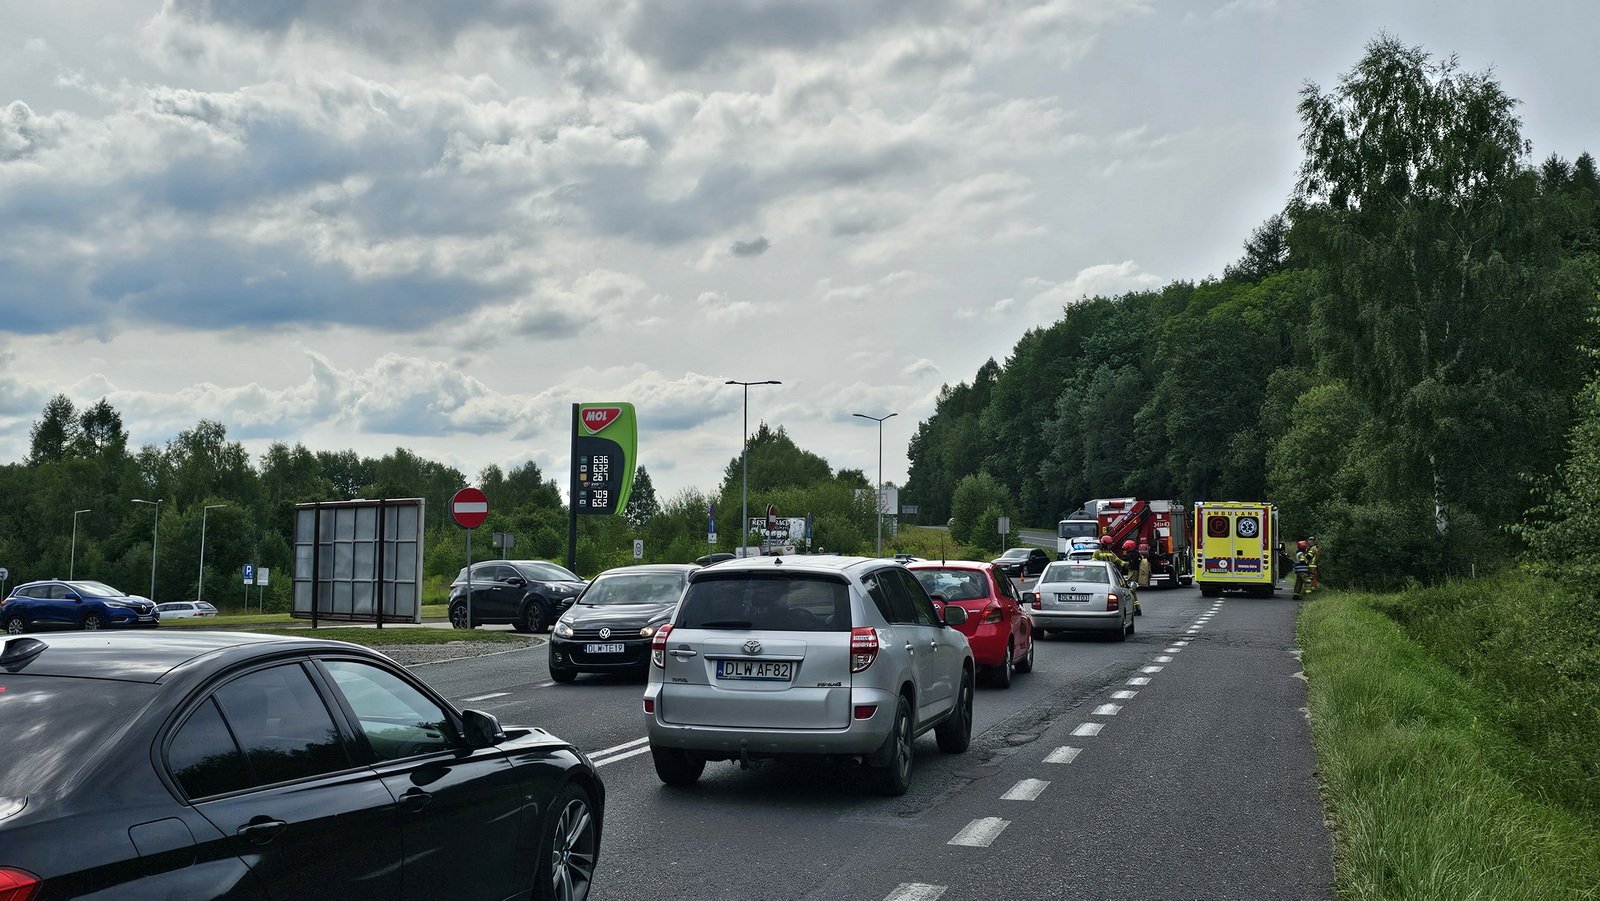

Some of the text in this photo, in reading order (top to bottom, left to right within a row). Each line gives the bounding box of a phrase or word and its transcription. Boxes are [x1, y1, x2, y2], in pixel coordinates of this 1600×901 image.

[586, 411, 608, 421] MOL
[725, 662, 789, 677] DLW AF82
